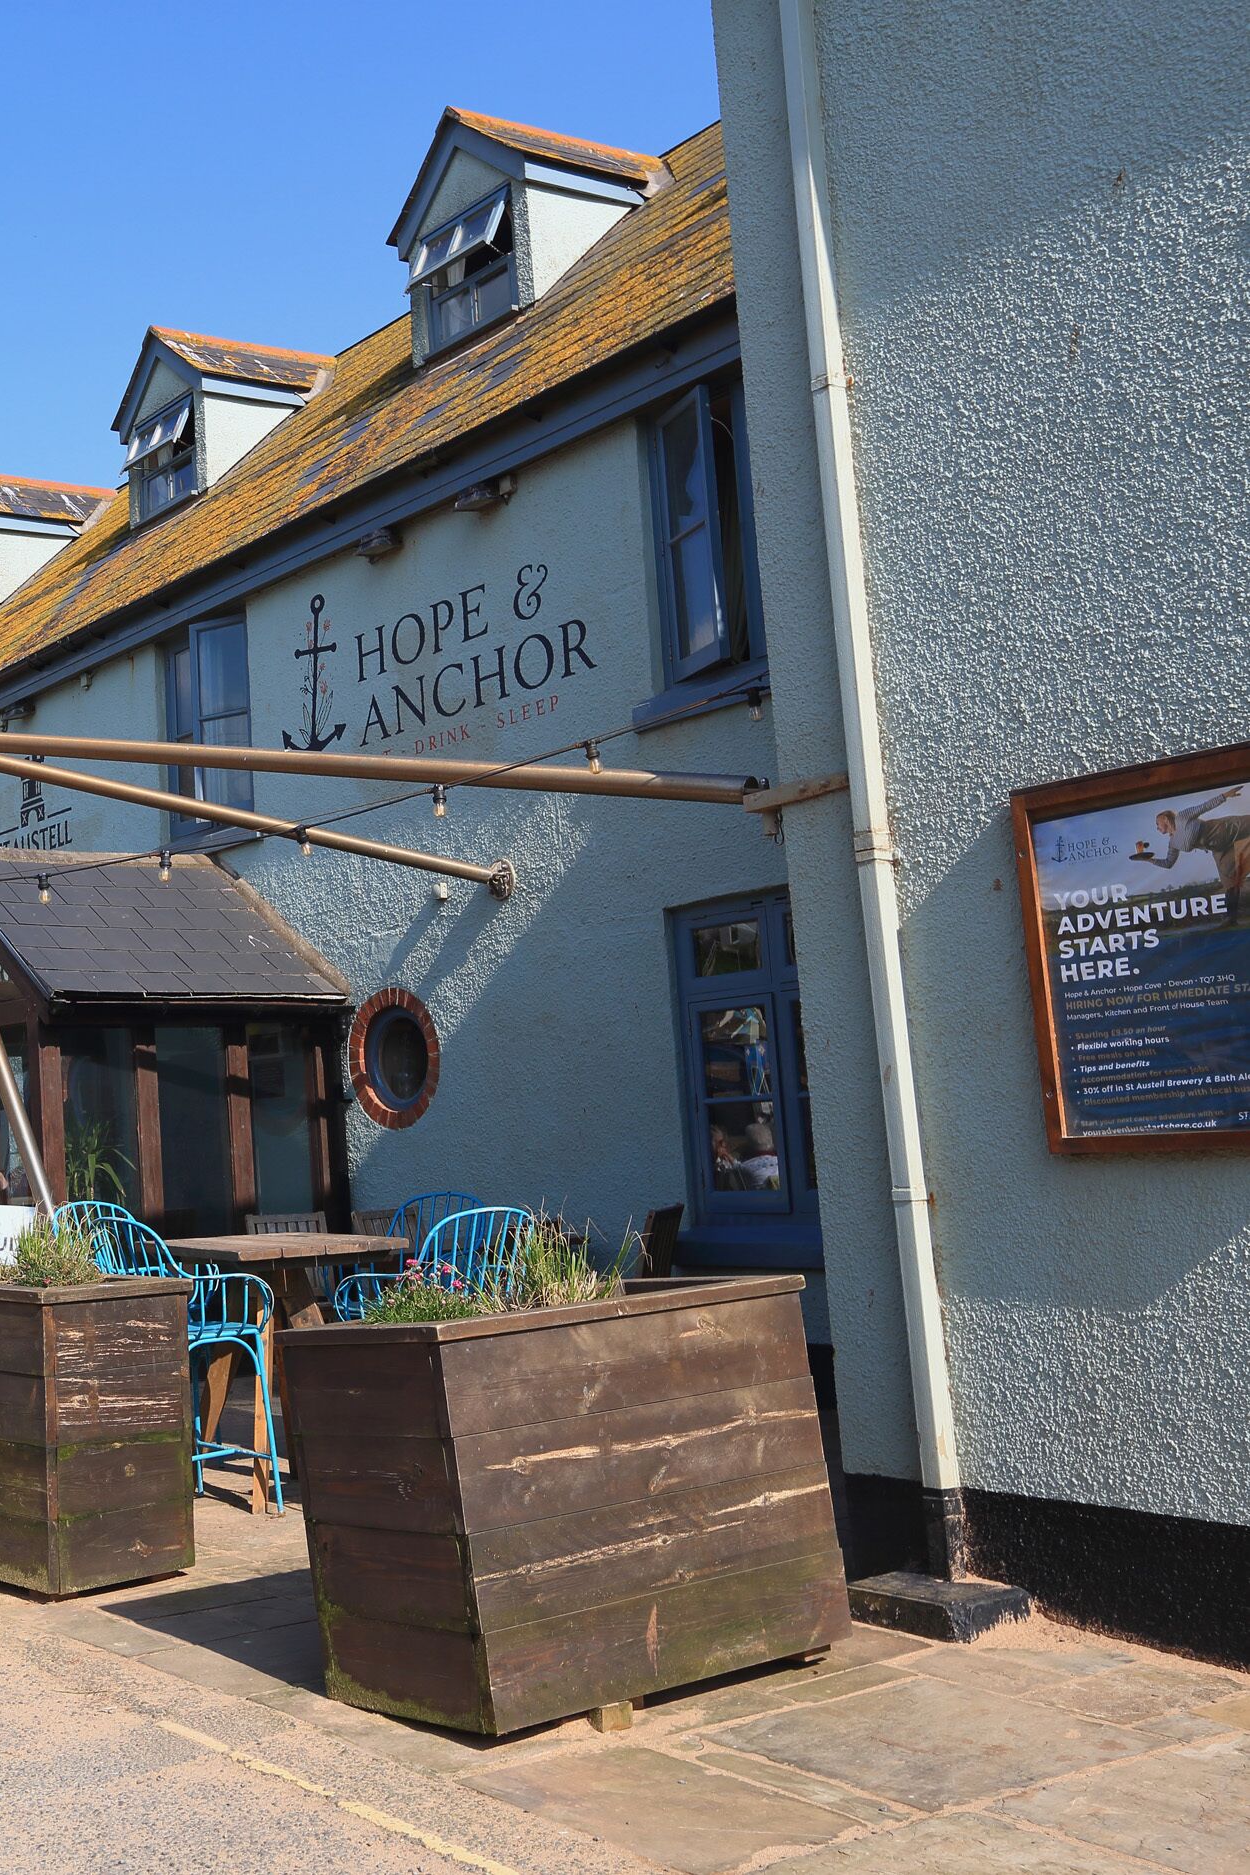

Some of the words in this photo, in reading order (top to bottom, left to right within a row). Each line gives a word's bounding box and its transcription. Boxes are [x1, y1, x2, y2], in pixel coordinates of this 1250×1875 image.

[354, 584, 489, 682] HOPE
[512, 564, 548, 620] &
[359, 619, 598, 747] ANCHOR
[414, 724, 471, 755] DRINK
[497, 695, 559, 729] SLEEP
[1067, 838, 1097, 852] HOPE
[1101, 836, 1110, 847] &
[1069, 845, 1119, 861] ANCHOR
[1053, 883, 1128, 911] YOUR
[1057, 893, 1228, 935] ADVENTURE
[1058, 928, 1160, 959] STARTS
[1060, 957, 1140, 983] HERE.
[1064, 991, 1083, 999] Hope
[1090, 987, 1117, 996] Anchor
[1123, 984, 1143, 993] Hope
[1144, 982, 1162, 990] Cove
[1168, 978, 1194, 987] Devon
[1199, 975, 1215, 984] TQ7
[1217, 973, 1236, 982] 3HQ
[1065, 998, 1103, 1010] HIRING
[1106, 995, 1134, 1007] NOW
[1137, 992, 1161, 1002] FOR
[1164, 985, 1230, 1000] IMMEDIATE
[1066, 1012, 1104, 1020] Managers,
[1104, 1008, 1131, 1017] Kitchen
[1133, 1006, 1148, 1014] and
[1149, 1004, 1170, 1012] Front
[1171, 1002, 1178, 1010] of
[1180, 1001, 1205, 1009] House
[1206, 999, 1229, 1007] Team
[1075, 1030, 1109, 1040] Starting
[1147, 1025, 1166, 1033] hour
[1077, 1041, 1108, 1051] Flexible
[1109, 1037, 1143, 1048] working
[1144, 1036, 1170, 1045] hours
[1078, 1053, 1096, 1061] Free
[1080, 1065, 1096, 1074] Tips
[1098, 1062, 1114, 1071] and
[1115, 1060, 1151, 1070] benefits
[1080, 1072, 1148, 1084] Accommodation
[1149, 1069, 1162, 1077] for
[1083, 1086, 1100, 1095] 30%
[1101, 1085, 1113, 1093] off
[1115, 1084, 1124, 1092] in
[1125, 1083, 1134, 1091] St
[1136, 1080, 1165, 1090] Austell
[1167, 1077, 1203, 1087] Brewery
[1205, 1075, 1212, 1083] &
[1214, 1074, 1236, 1082] Bath
[1084, 1095, 1130, 1106] Discounted
[1132, 1090, 1186, 1101] membership
[1187, 1088, 1208, 1097] with
[1210, 1087, 1232, 1095] local
